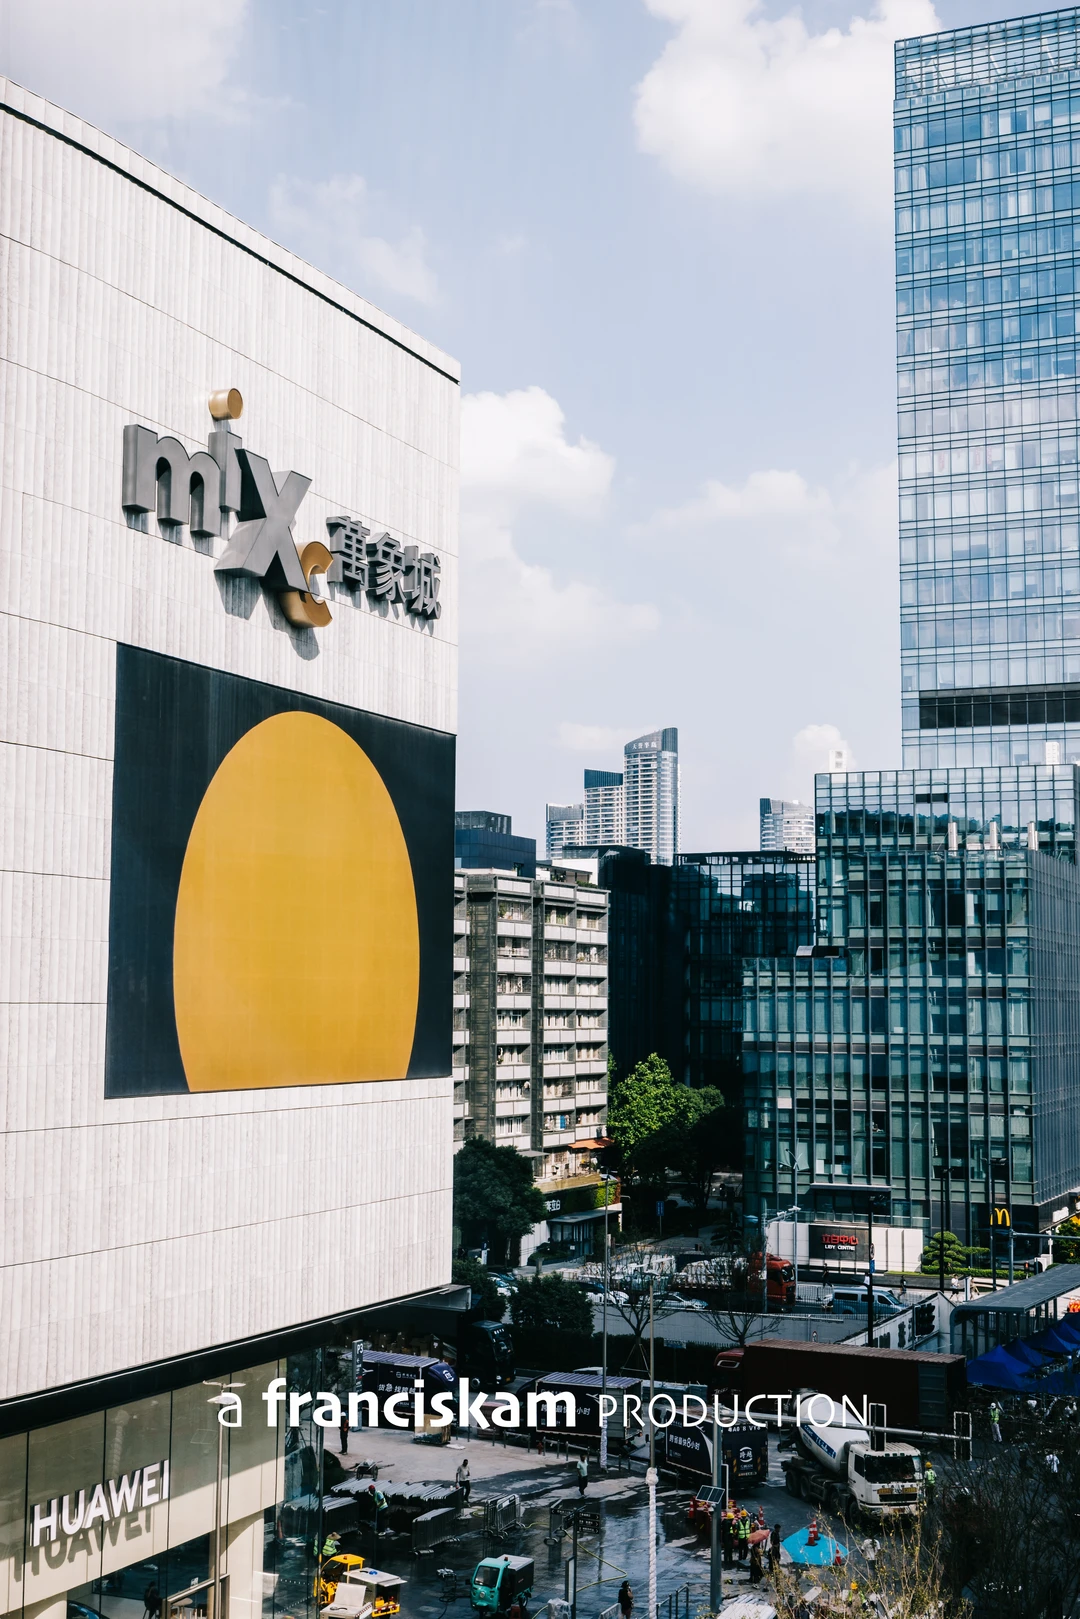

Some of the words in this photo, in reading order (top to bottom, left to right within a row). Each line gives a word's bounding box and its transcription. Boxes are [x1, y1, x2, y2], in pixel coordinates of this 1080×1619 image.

[821, 1234, 859, 1246] 立白中心
[29, 1459, 170, 1547] HUAWEI
